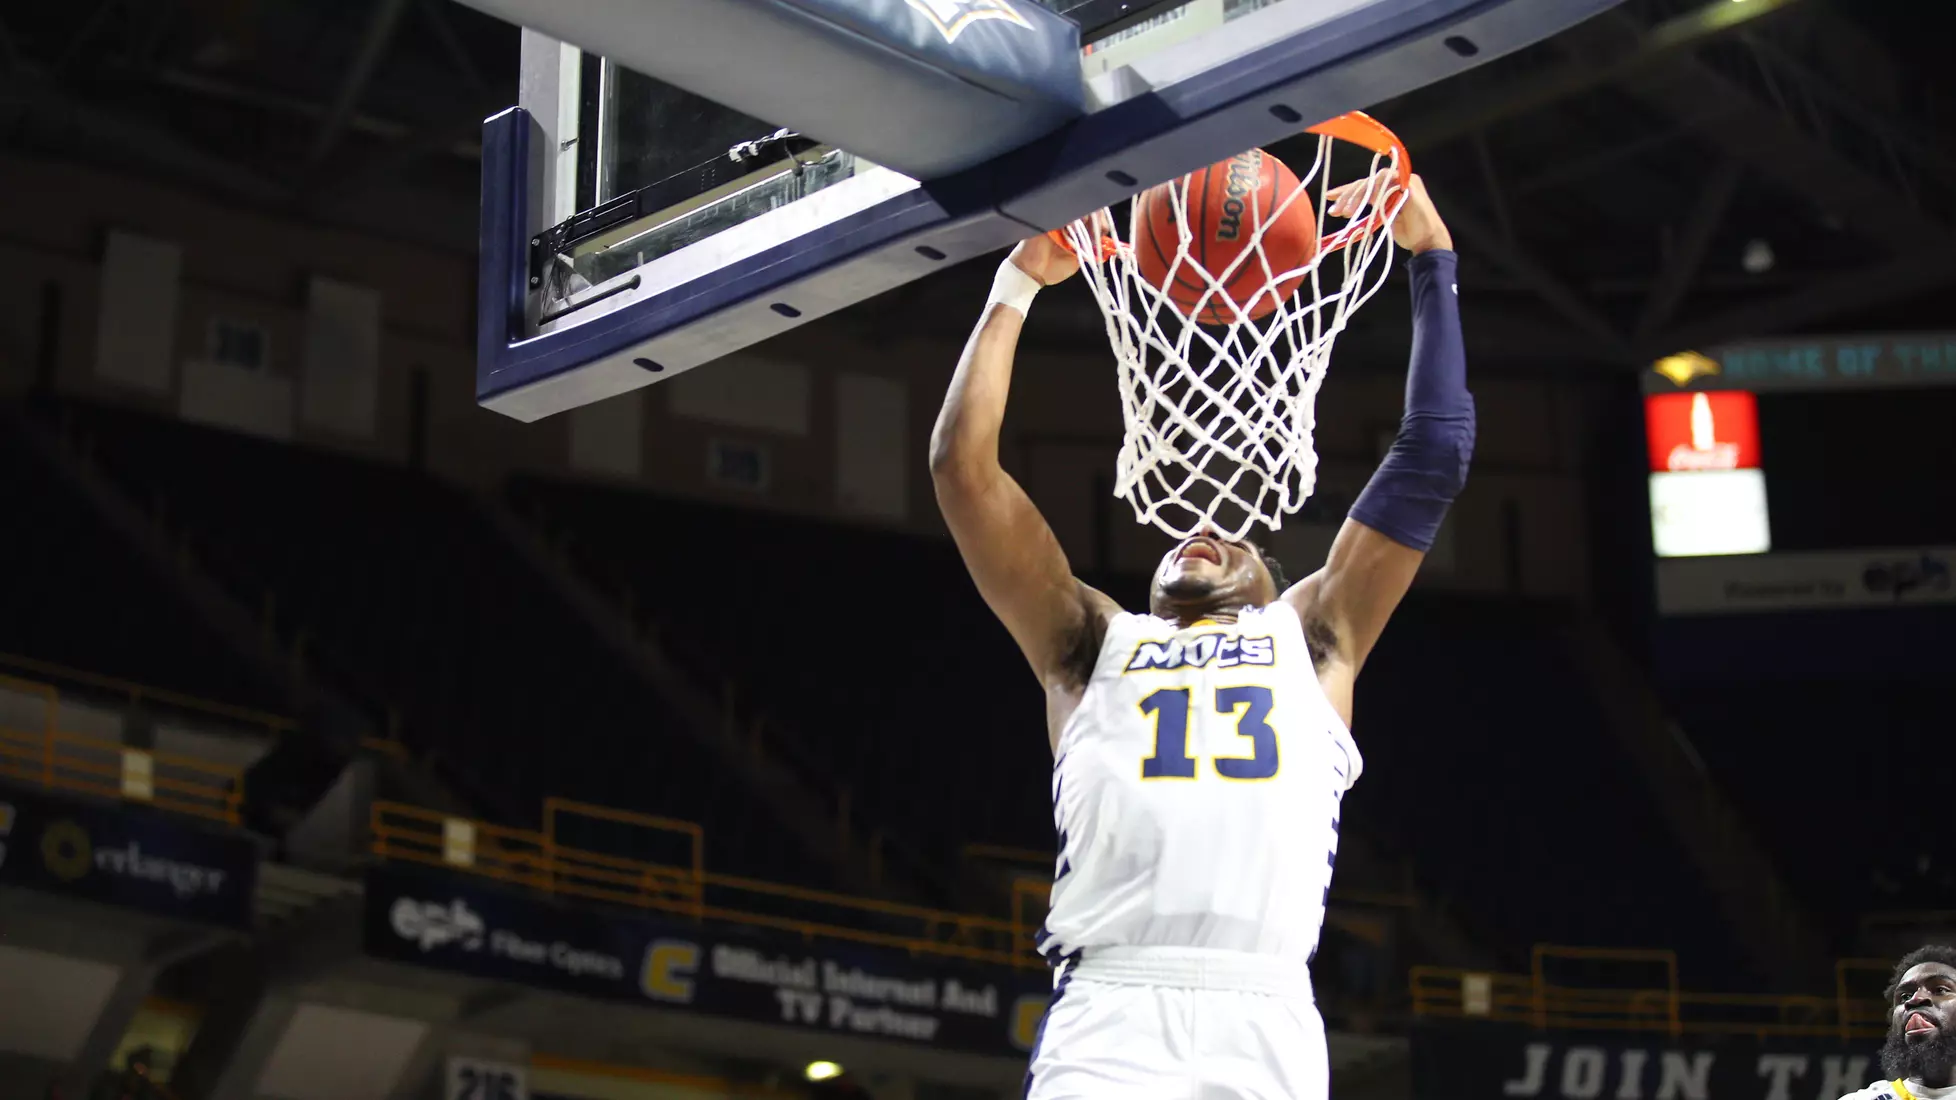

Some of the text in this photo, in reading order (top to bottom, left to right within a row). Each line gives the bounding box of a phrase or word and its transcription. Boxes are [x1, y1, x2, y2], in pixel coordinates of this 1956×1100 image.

[1123, 632, 1275, 674] MOCS
[1137, 683, 1281, 781] 13
[711, 943, 818, 989] Official
[822, 959, 937, 1009] Internet
[773, 987, 942, 1042] TV Partner
[1504, 1043, 1717, 1100] JOIN
